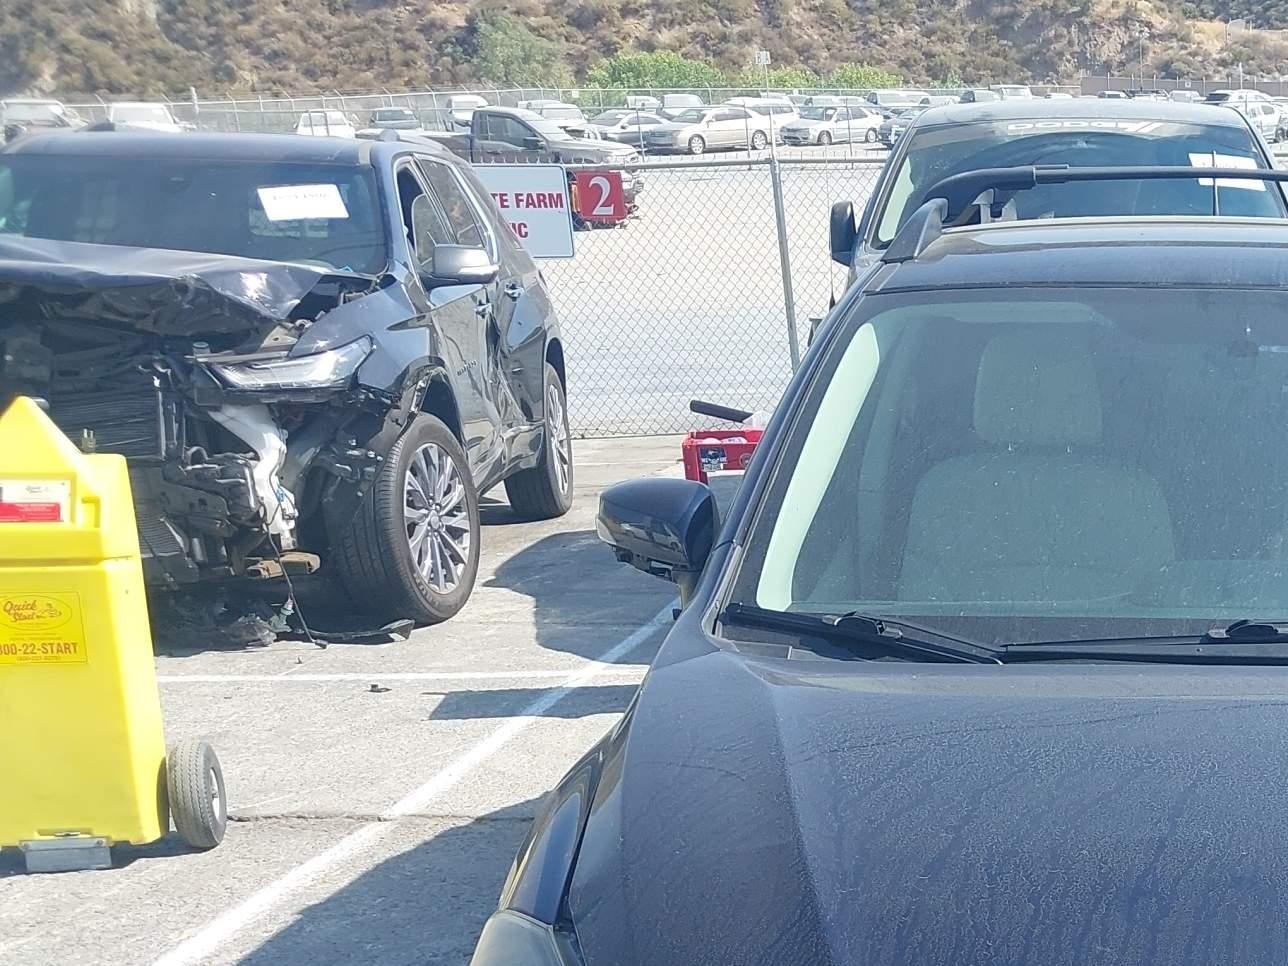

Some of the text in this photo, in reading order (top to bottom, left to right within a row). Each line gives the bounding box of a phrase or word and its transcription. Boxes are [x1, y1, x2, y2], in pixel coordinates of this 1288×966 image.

[515, 193, 564, 209] FARM
[588, 176, 614, 216] 2
[3, 600, 37, 615] Quick
